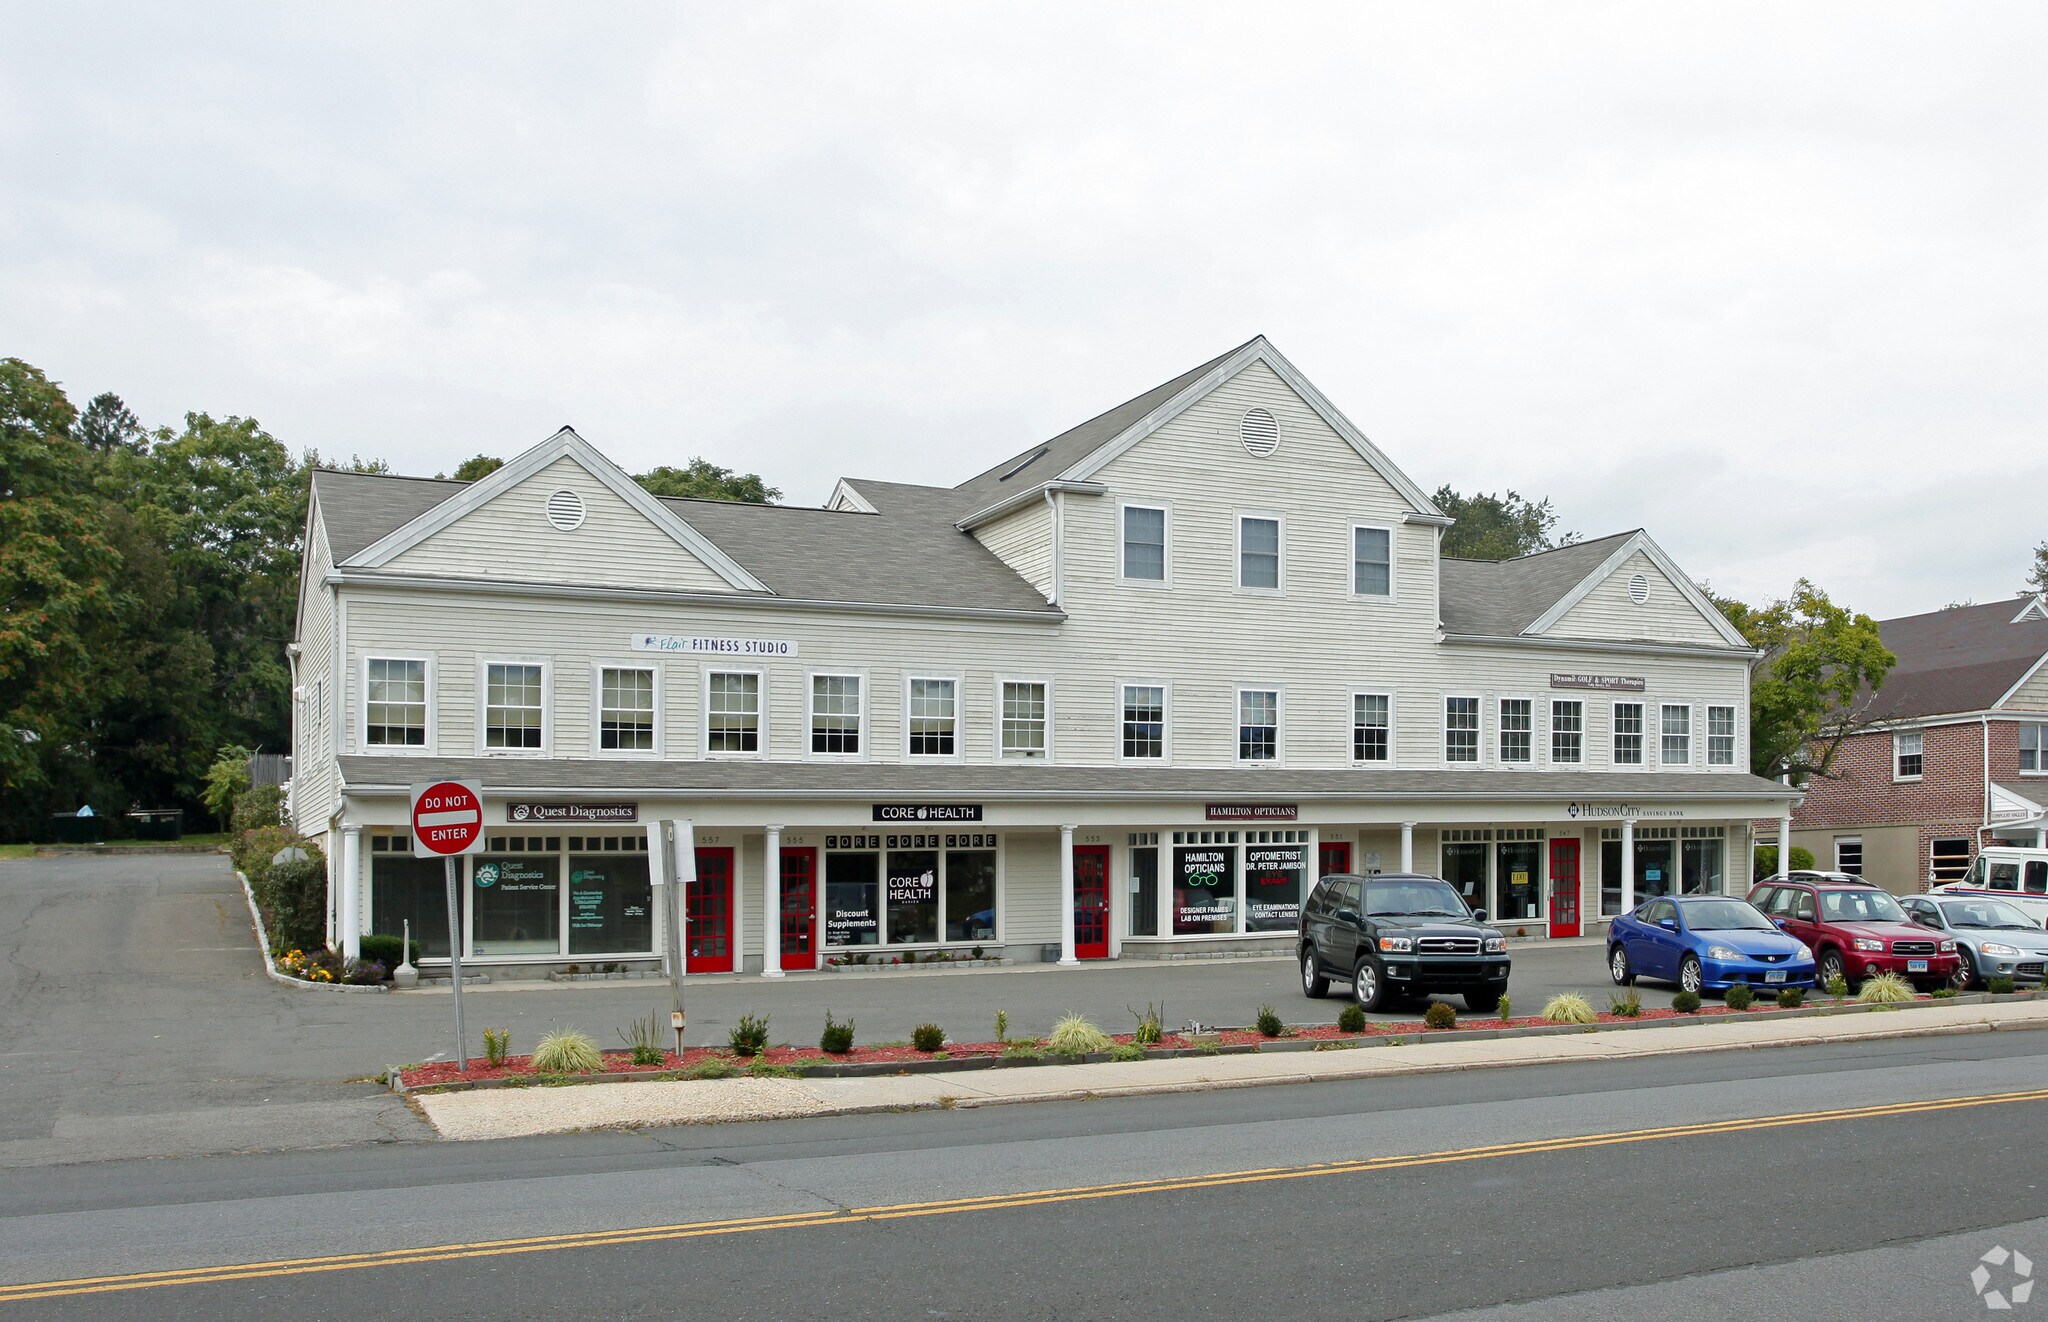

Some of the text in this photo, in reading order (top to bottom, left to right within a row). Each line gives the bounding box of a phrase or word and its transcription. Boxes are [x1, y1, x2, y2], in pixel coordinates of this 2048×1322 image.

[660, 637, 788, 654] Flair FITNESS STUDIO
[1578, 675, 1593, 683] GOLF
[1601, 676, 1619, 684] SPORT
[425, 795, 468, 809] DO NOT
[533, 805, 633, 819] Quest Diagnostics
[881, 807, 974, 819] CORE HEALTH
[1210, 807, 1296, 816] HAMILTON OPTICIANS
[431, 828, 468, 841] ENTER
[702, 836, 720, 844] 557
[787, 836, 804, 844] 555
[1185, 853, 1224, 862] HAMILTON
[1250, 851, 1301, 861] OPTOMETRIST
[501, 862, 524, 871] Quest
[1184, 863, 1225, 874] OPTICIANS
[1246, 861, 1306, 871] DR. PETER JAMISON
[501, 871, 544, 881] Diagnostics
[889, 877, 919, 888] CORE
[889, 889, 931, 900] HEALTH
[1263, 903, 1300, 911] EXAMINATIONS
[836, 910, 869, 918] Discount
[1254, 911, 1278, 919] CONTACT
[827, 919, 877, 929] Supplements
